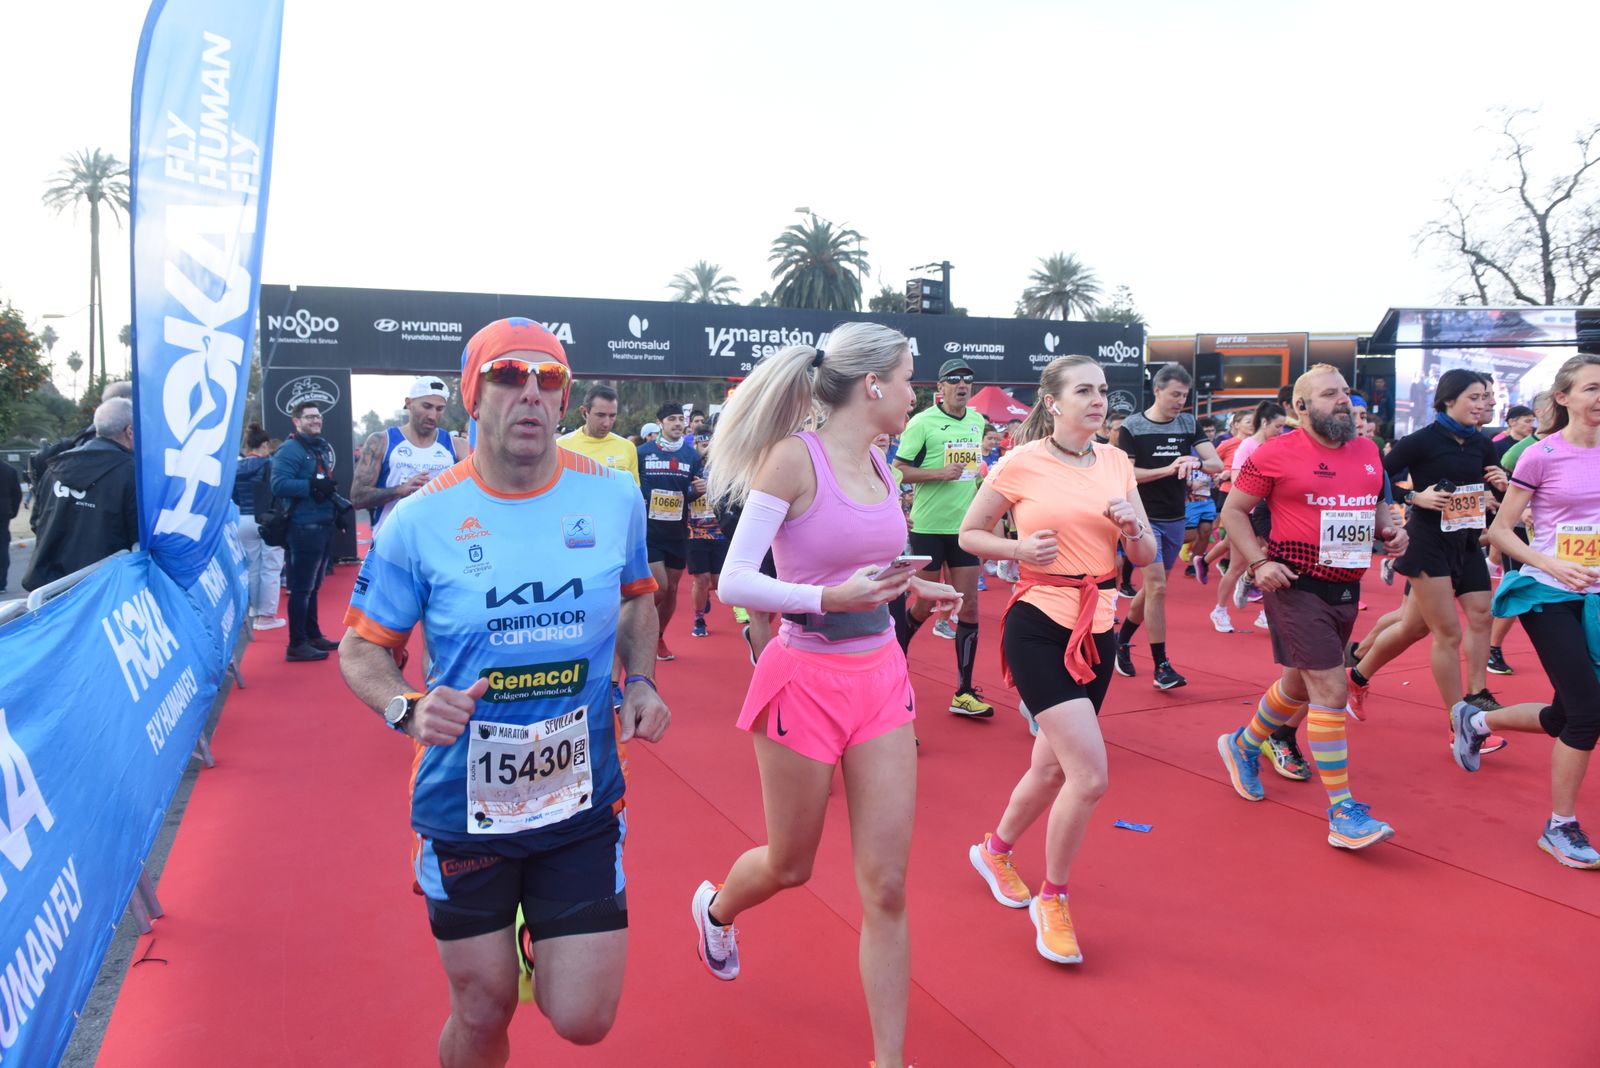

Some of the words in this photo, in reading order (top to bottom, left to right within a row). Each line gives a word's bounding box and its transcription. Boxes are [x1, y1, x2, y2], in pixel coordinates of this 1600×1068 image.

[199, 30, 232, 191] HUMAN
[165, 110, 197, 183] FLY
[230, 129, 260, 195] FLY
[401, 321, 462, 333] HYUNDAI
[729, 327, 814, 345] maratón
[963, 344, 1005, 353] HYUNDAI
[153, 204, 258, 541] HOKA
[948, 452, 977, 464] 10584
[653, 496, 680, 508] 10660
[1304, 493, 1337, 506] Los
[1449, 495, 1476, 511] 3839
[1327, 525, 1371, 542] 14951
[486, 578, 584, 609] KIA
[102, 587, 179, 702] HOKA
[489, 664, 580, 690] Genacol
[493, 690, 530, 702] Colágeno
[498, 726, 529, 739] MARATÓN
[545, 712, 574, 735] SEVILLA
[478, 739, 572, 785] 15430
[0, 899, 63, 1061] UMAN
[49, 853, 84, 937] FLY
